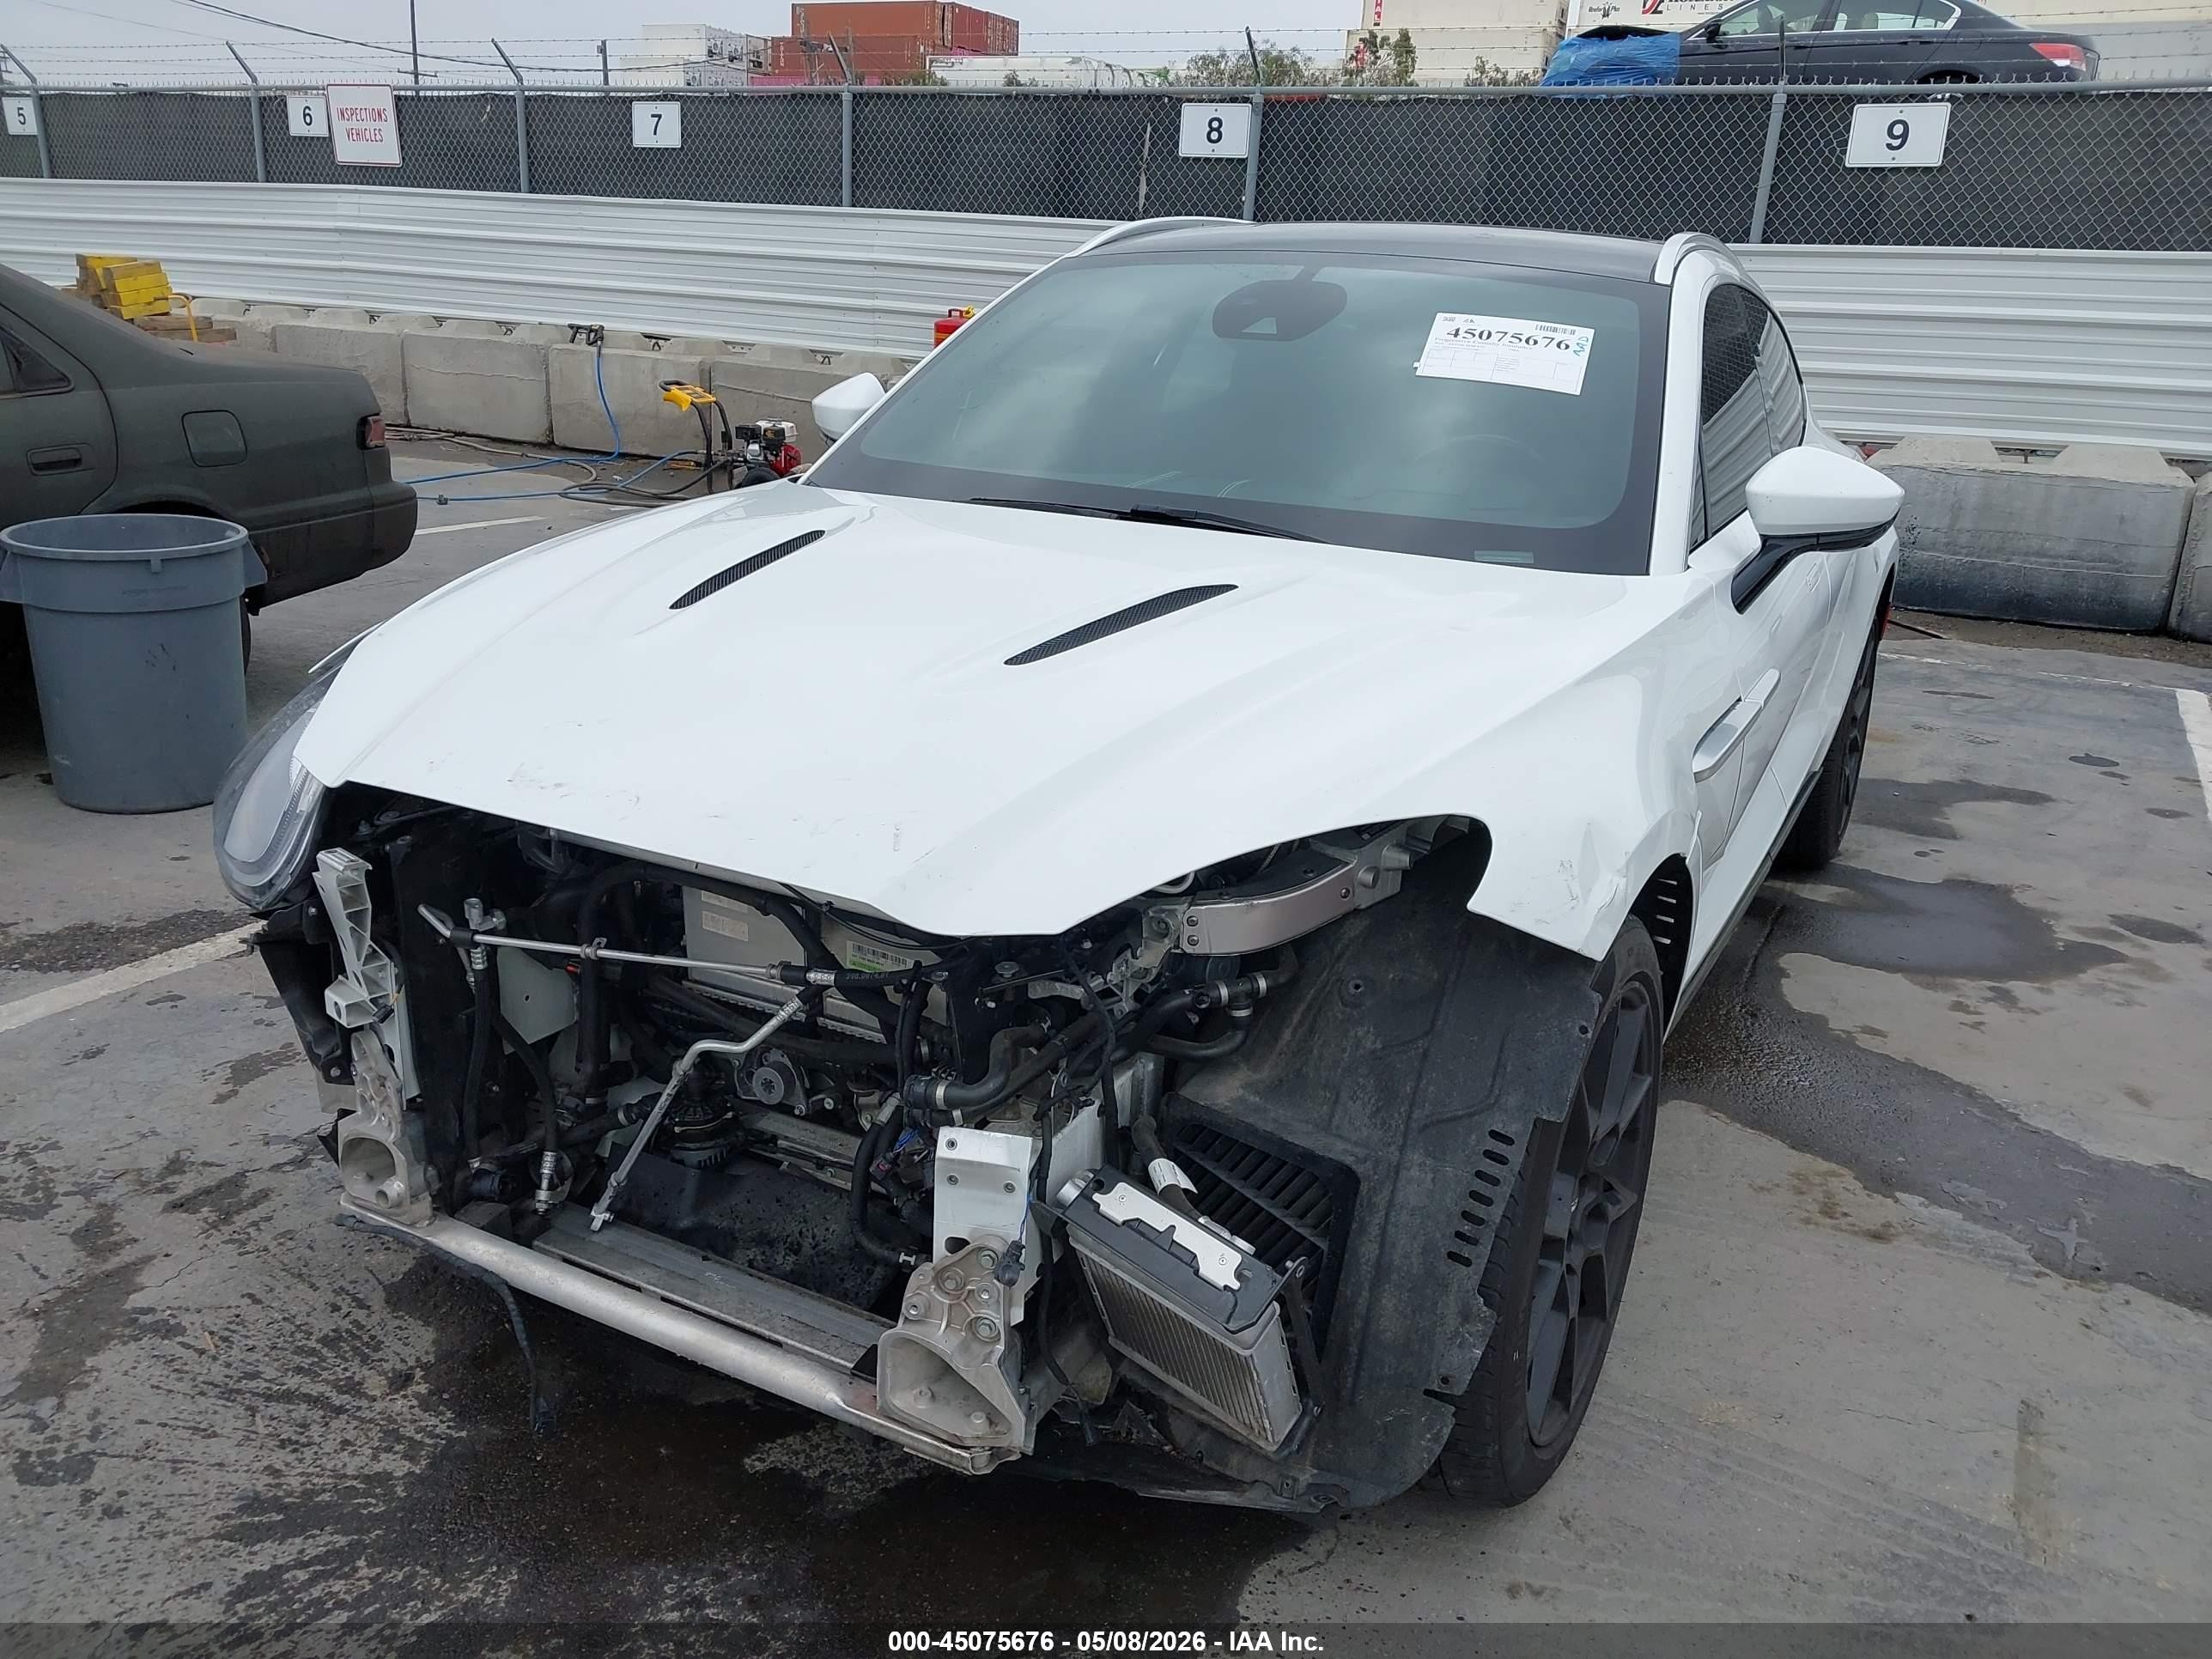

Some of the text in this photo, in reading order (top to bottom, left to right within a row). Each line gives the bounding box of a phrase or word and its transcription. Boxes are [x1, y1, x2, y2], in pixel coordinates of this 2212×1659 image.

[17, 106, 26, 125] 5
[302, 106, 313, 126] 6
[337, 107, 388, 123] INSPECTIONS
[650, 113, 662, 136] 7
[345, 127, 384, 143] VEHICLES
[1206, 116, 1223, 144] 8
[1886, 118, 1910, 151] 9
[1446, 326, 1571, 350] 45075676
